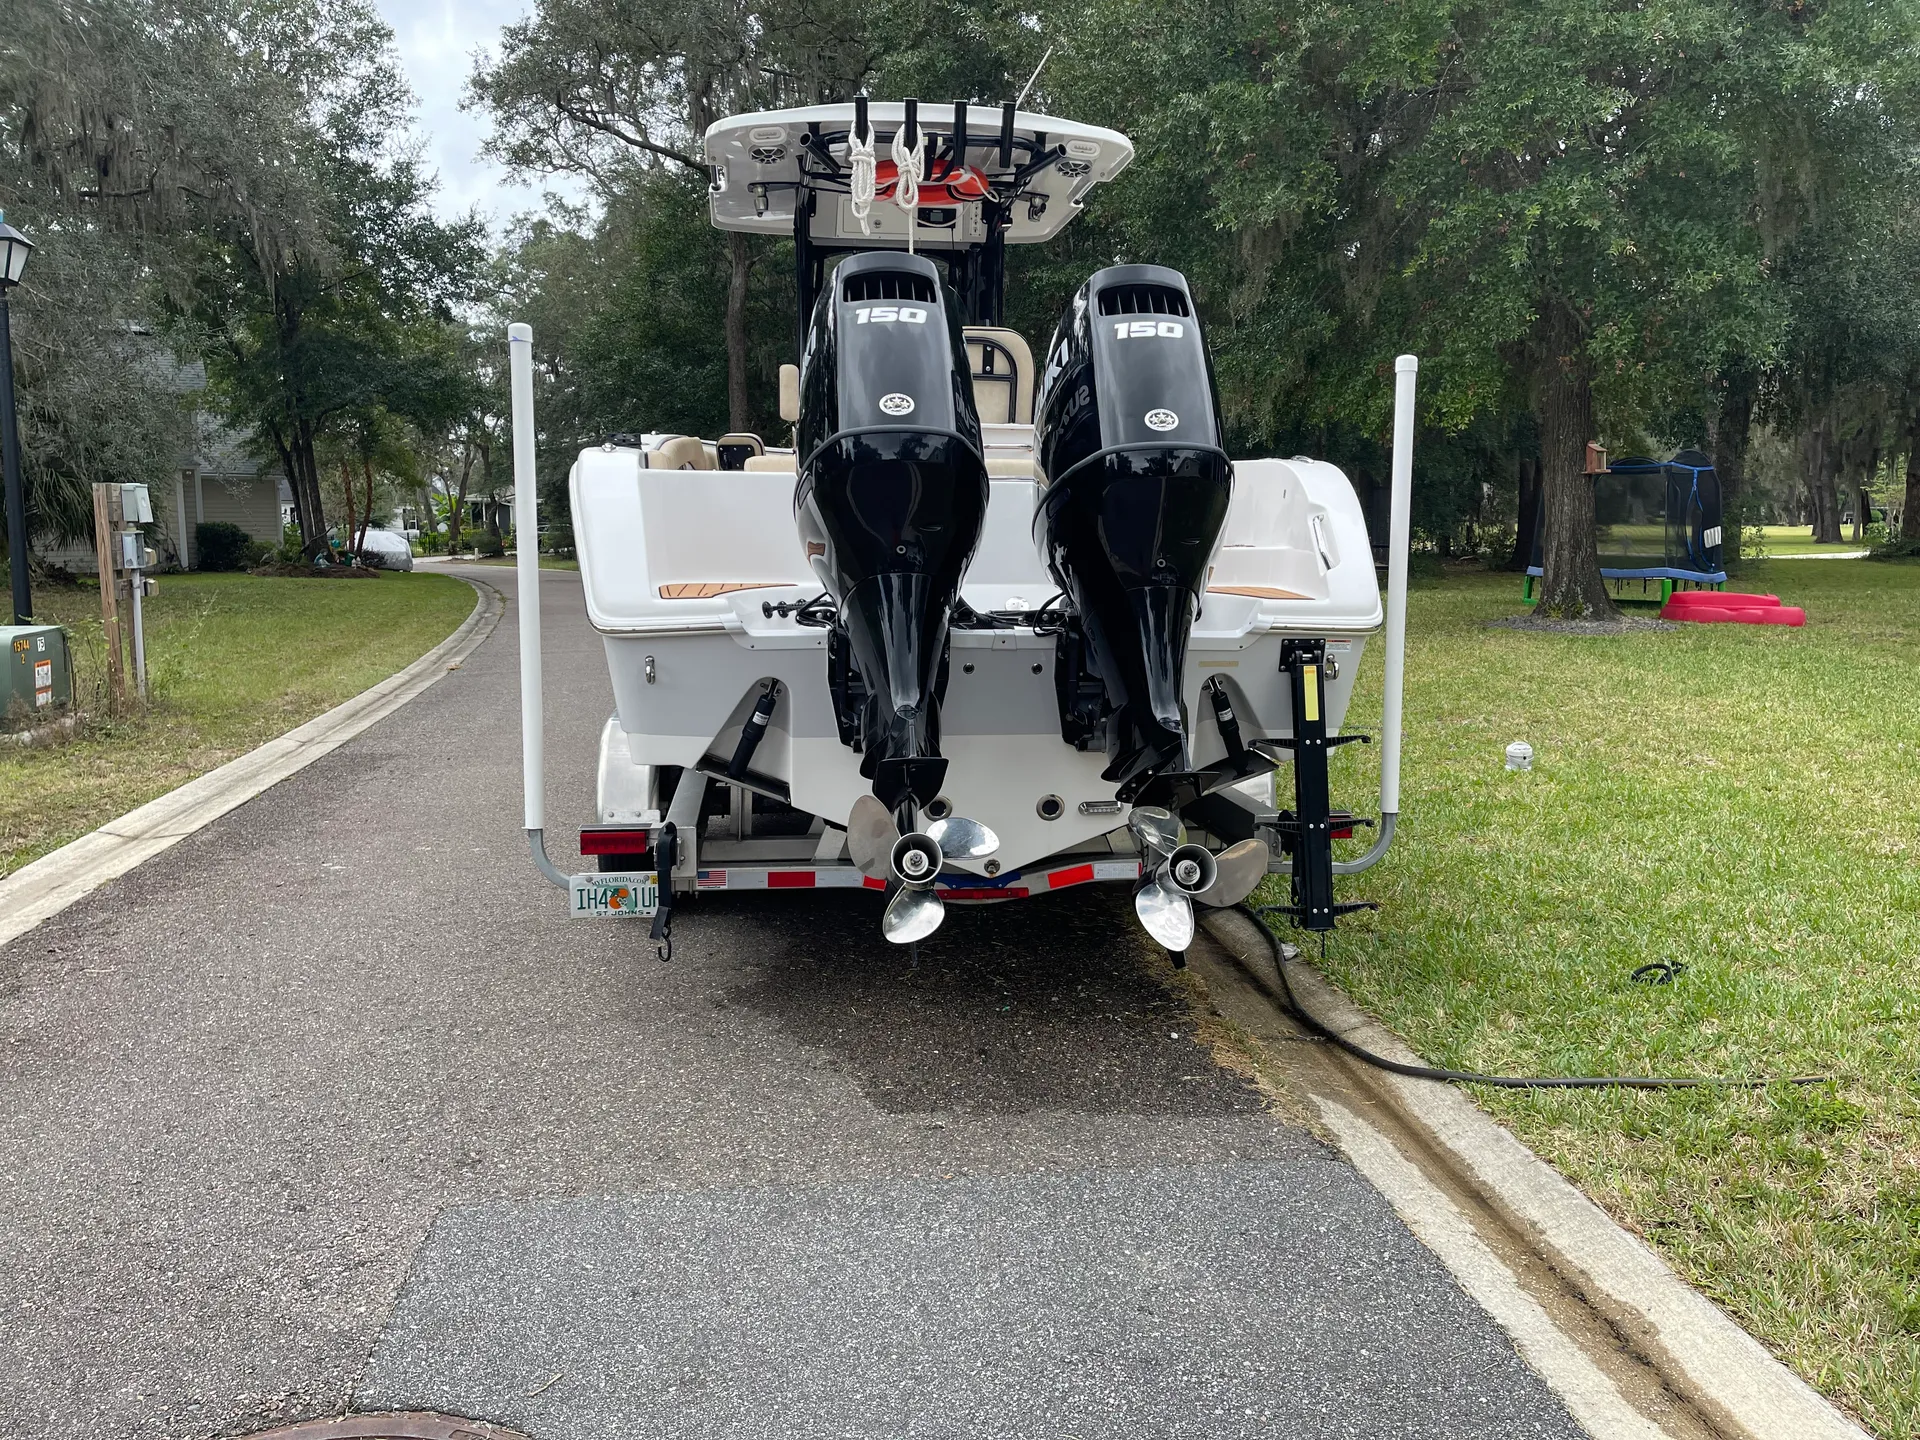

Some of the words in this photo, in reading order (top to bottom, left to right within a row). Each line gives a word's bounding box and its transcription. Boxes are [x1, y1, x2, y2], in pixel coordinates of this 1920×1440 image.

[855, 308, 927, 324] 150
[1114, 321, 1184, 339] 150
[14, 639, 30, 652] 15744
